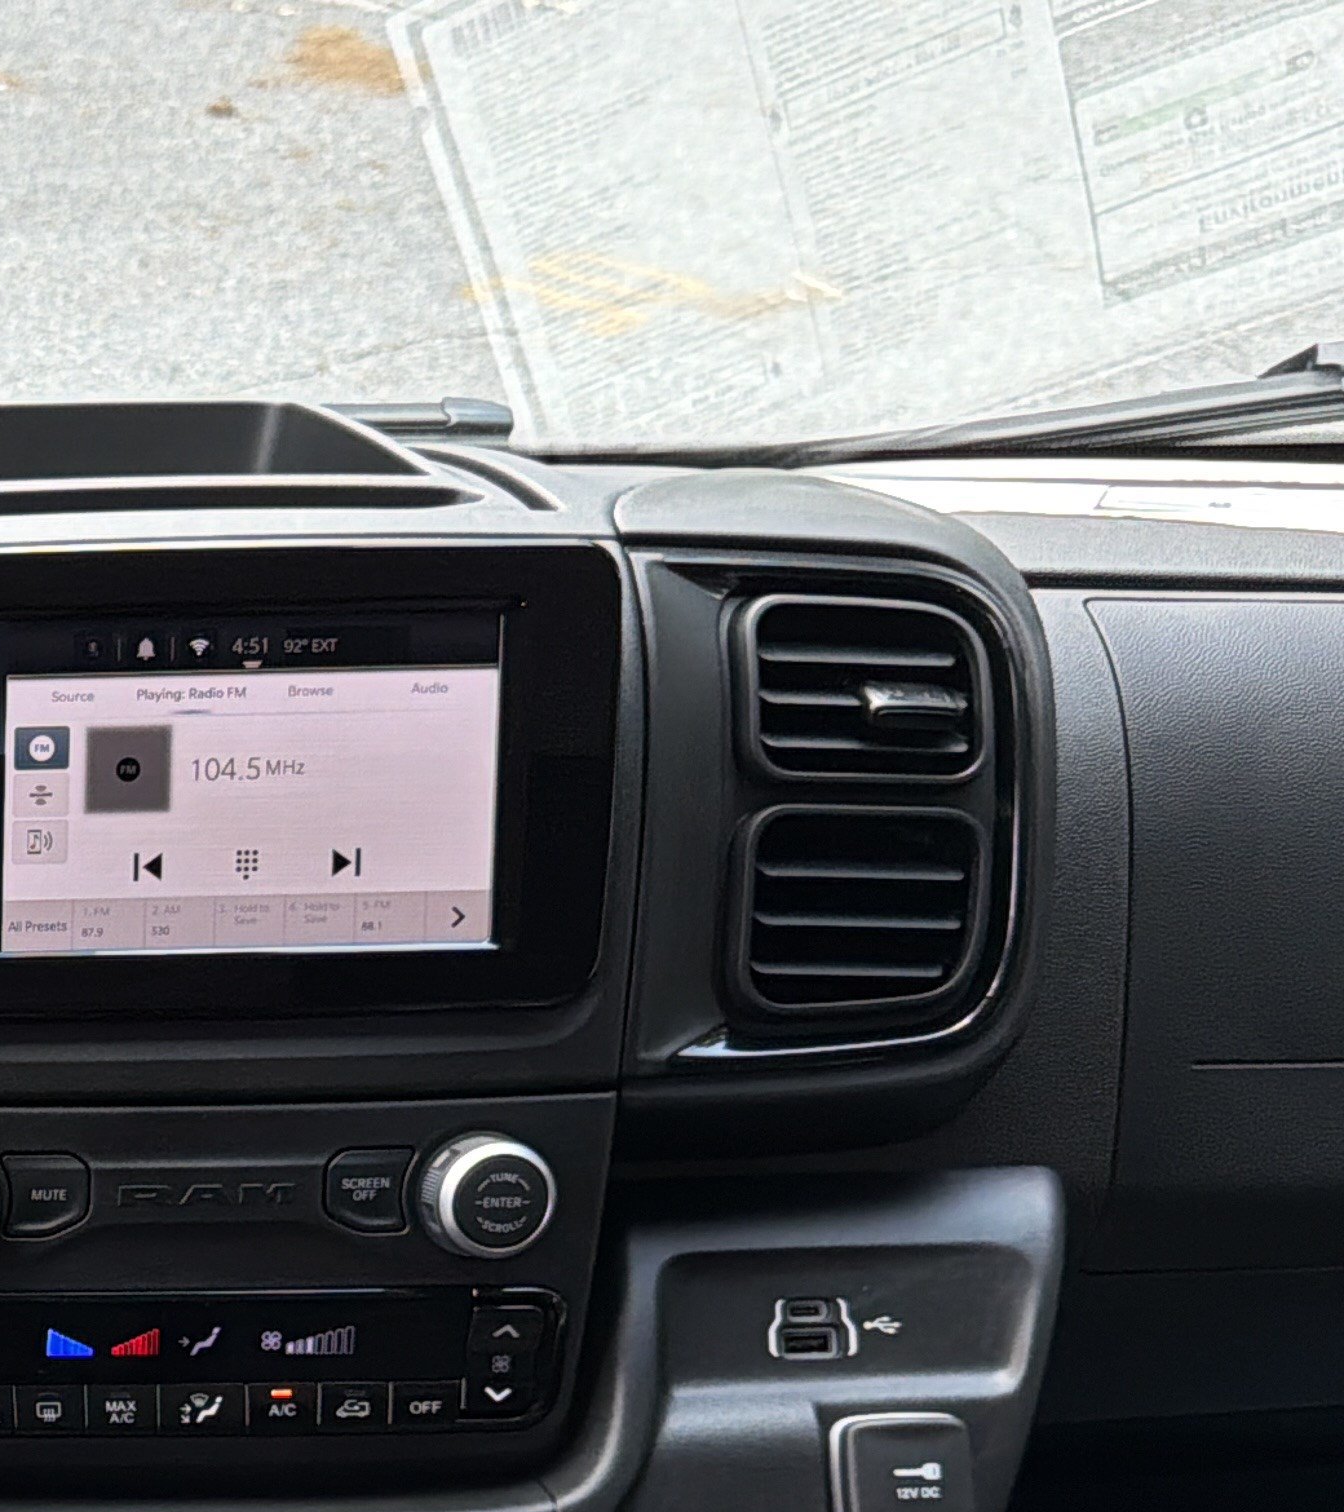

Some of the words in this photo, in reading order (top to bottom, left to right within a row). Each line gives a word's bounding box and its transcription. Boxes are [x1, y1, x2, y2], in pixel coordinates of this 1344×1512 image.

[231, 637, 270, 656] 4:51
[311, 638, 339, 652] EXT
[136, 688, 186, 703] Playing:
[188, 687, 225, 700] Radio
[226, 686, 248, 699] FM
[287, 685, 335, 698] Browse
[411, 682, 449, 696] Audio
[51, 690, 96, 703] Source
[33, 743, 51, 754] FM
[190, 756, 262, 783] 104.5
[265, 759, 306, 776] MHz
[8, 920, 23, 933] All
[25, 920, 68, 933] Presets
[81, 926, 105, 938] 87.9
[340, 1177, 391, 1191] SCREEN
[489, 1172, 520, 1184] TUNE
[30, 1188, 68, 1202] MUTE
[117, 1183, 298, 1206] RAM
[352, 1188, 378, 1201] OFF
[481, 1218, 523, 1234] SCROLL
[105, 1400, 138, 1413] MAX
[267, 1403, 298, 1417] A/C
[408, 1400, 443, 1415] OFF
[109, 1411, 137, 1425] A/C
[896, 1487, 920, 1500] 12V
[920, 1485, 943, 1499] DC
